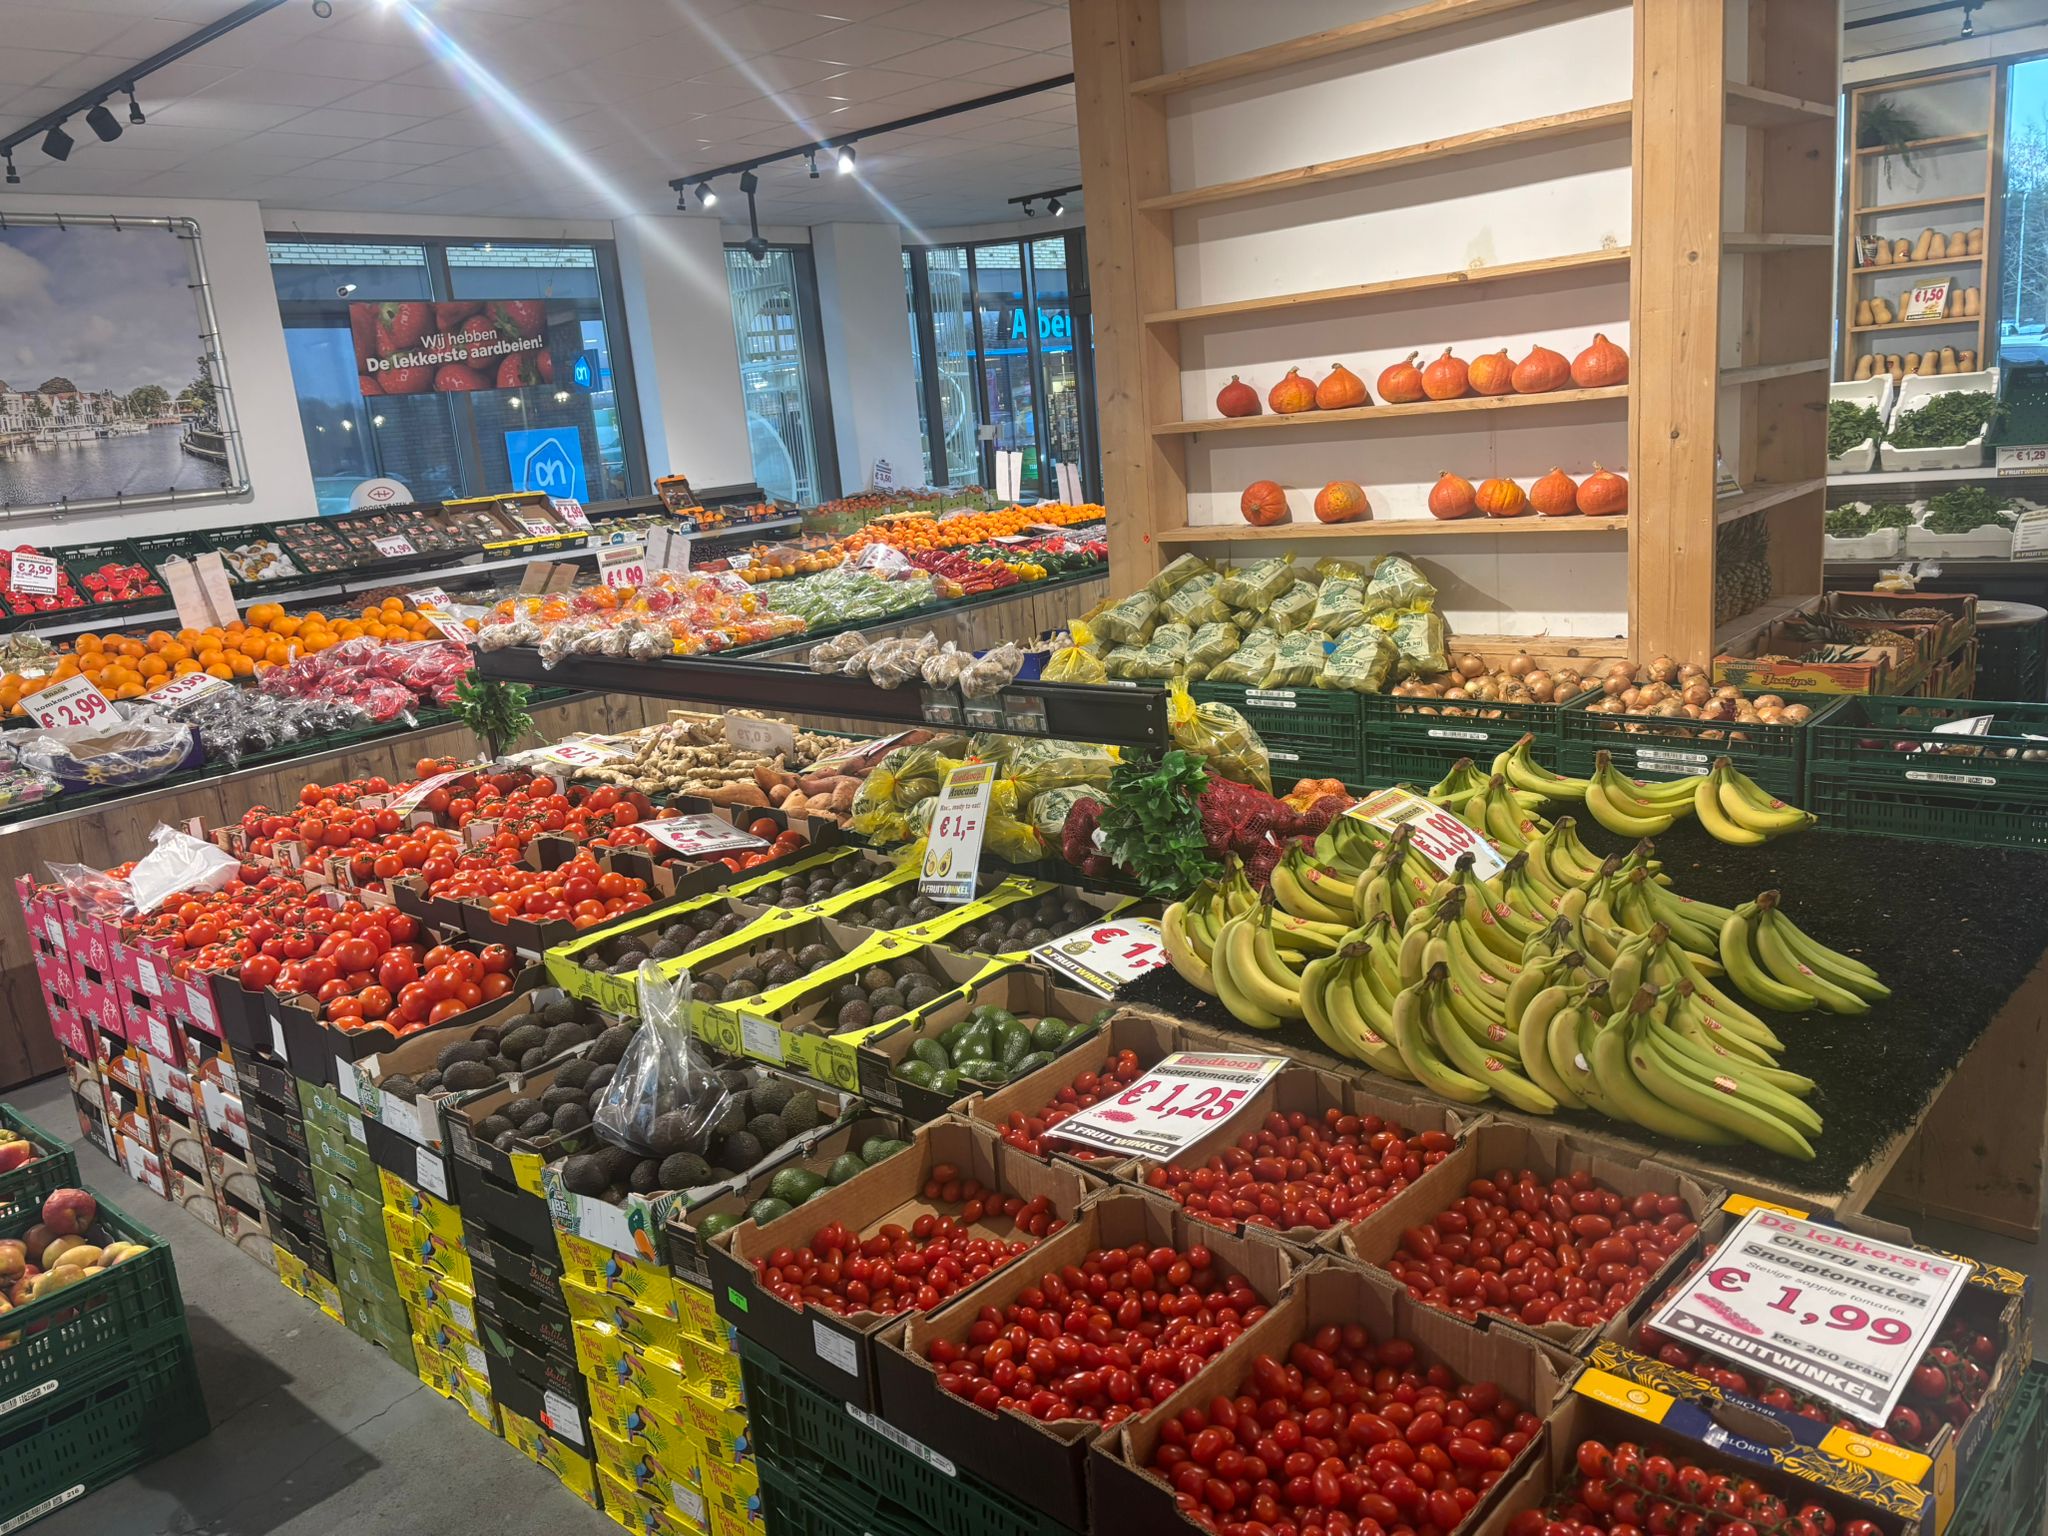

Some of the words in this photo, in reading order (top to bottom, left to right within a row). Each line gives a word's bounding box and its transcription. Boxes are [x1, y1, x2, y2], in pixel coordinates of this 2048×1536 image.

[421, 333, 446, 350] Wij
[448, 328, 498, 346] hebben
[366, 358, 390, 373] De
[392, 346, 468, 369] lekkerste
[470, 335, 543, 359] aardbeien!
[2025, 450, 2046, 461] 1,29
[392, 544, 411, 554] 2,99
[18, 563, 26, 572] €
[28, 563, 53, 576] 2,99
[166, 674, 208, 694] 0,99
[34, 686, 90, 713] komkommers
[58, 693, 107, 727] 2,99
[949, 786, 979, 797] Avocado
[1388, 805, 1426, 824] Bananen
[664, 824, 713, 832] Tomaten
[940, 816, 951, 838] €
[1092, 928, 1130, 945] €
[1050, 951, 1115, 993] FRUITWINKEL
[1177, 1056, 1264, 1071] Goedkoop!
[1153, 1067, 1263, 1085] Snoeptomaatjes
[1117, 1079, 1161, 1106] €
[1147, 1083, 1250, 1121] 1,25
[1074, 1126, 1171, 1155] FRUITWINKEL
[1773, 1231, 1859, 1267] Cherry
[1864, 1259, 1921, 1285] star
[1803, 1224, 1950, 1279] lekkerste
[1742, 1242, 1929, 1309] Snoeptomaten
[1745, 1260, 1795, 1284] Stevige
[1795, 1274, 1848, 1300] sappige
[1849, 1292, 1906, 1317] tomaten
[1708, 1266, 1752, 1294] €
[1766, 1285, 1912, 1347] 1,99
[1696, 1320, 1880, 1404] FRUITWINKEL
[1771, 1331, 1802, 1348] Per
[1803, 1340, 1841, 1363] 250
[1843, 1357, 1891, 1384] gram
[66, 1487, 80, 1498] 216
